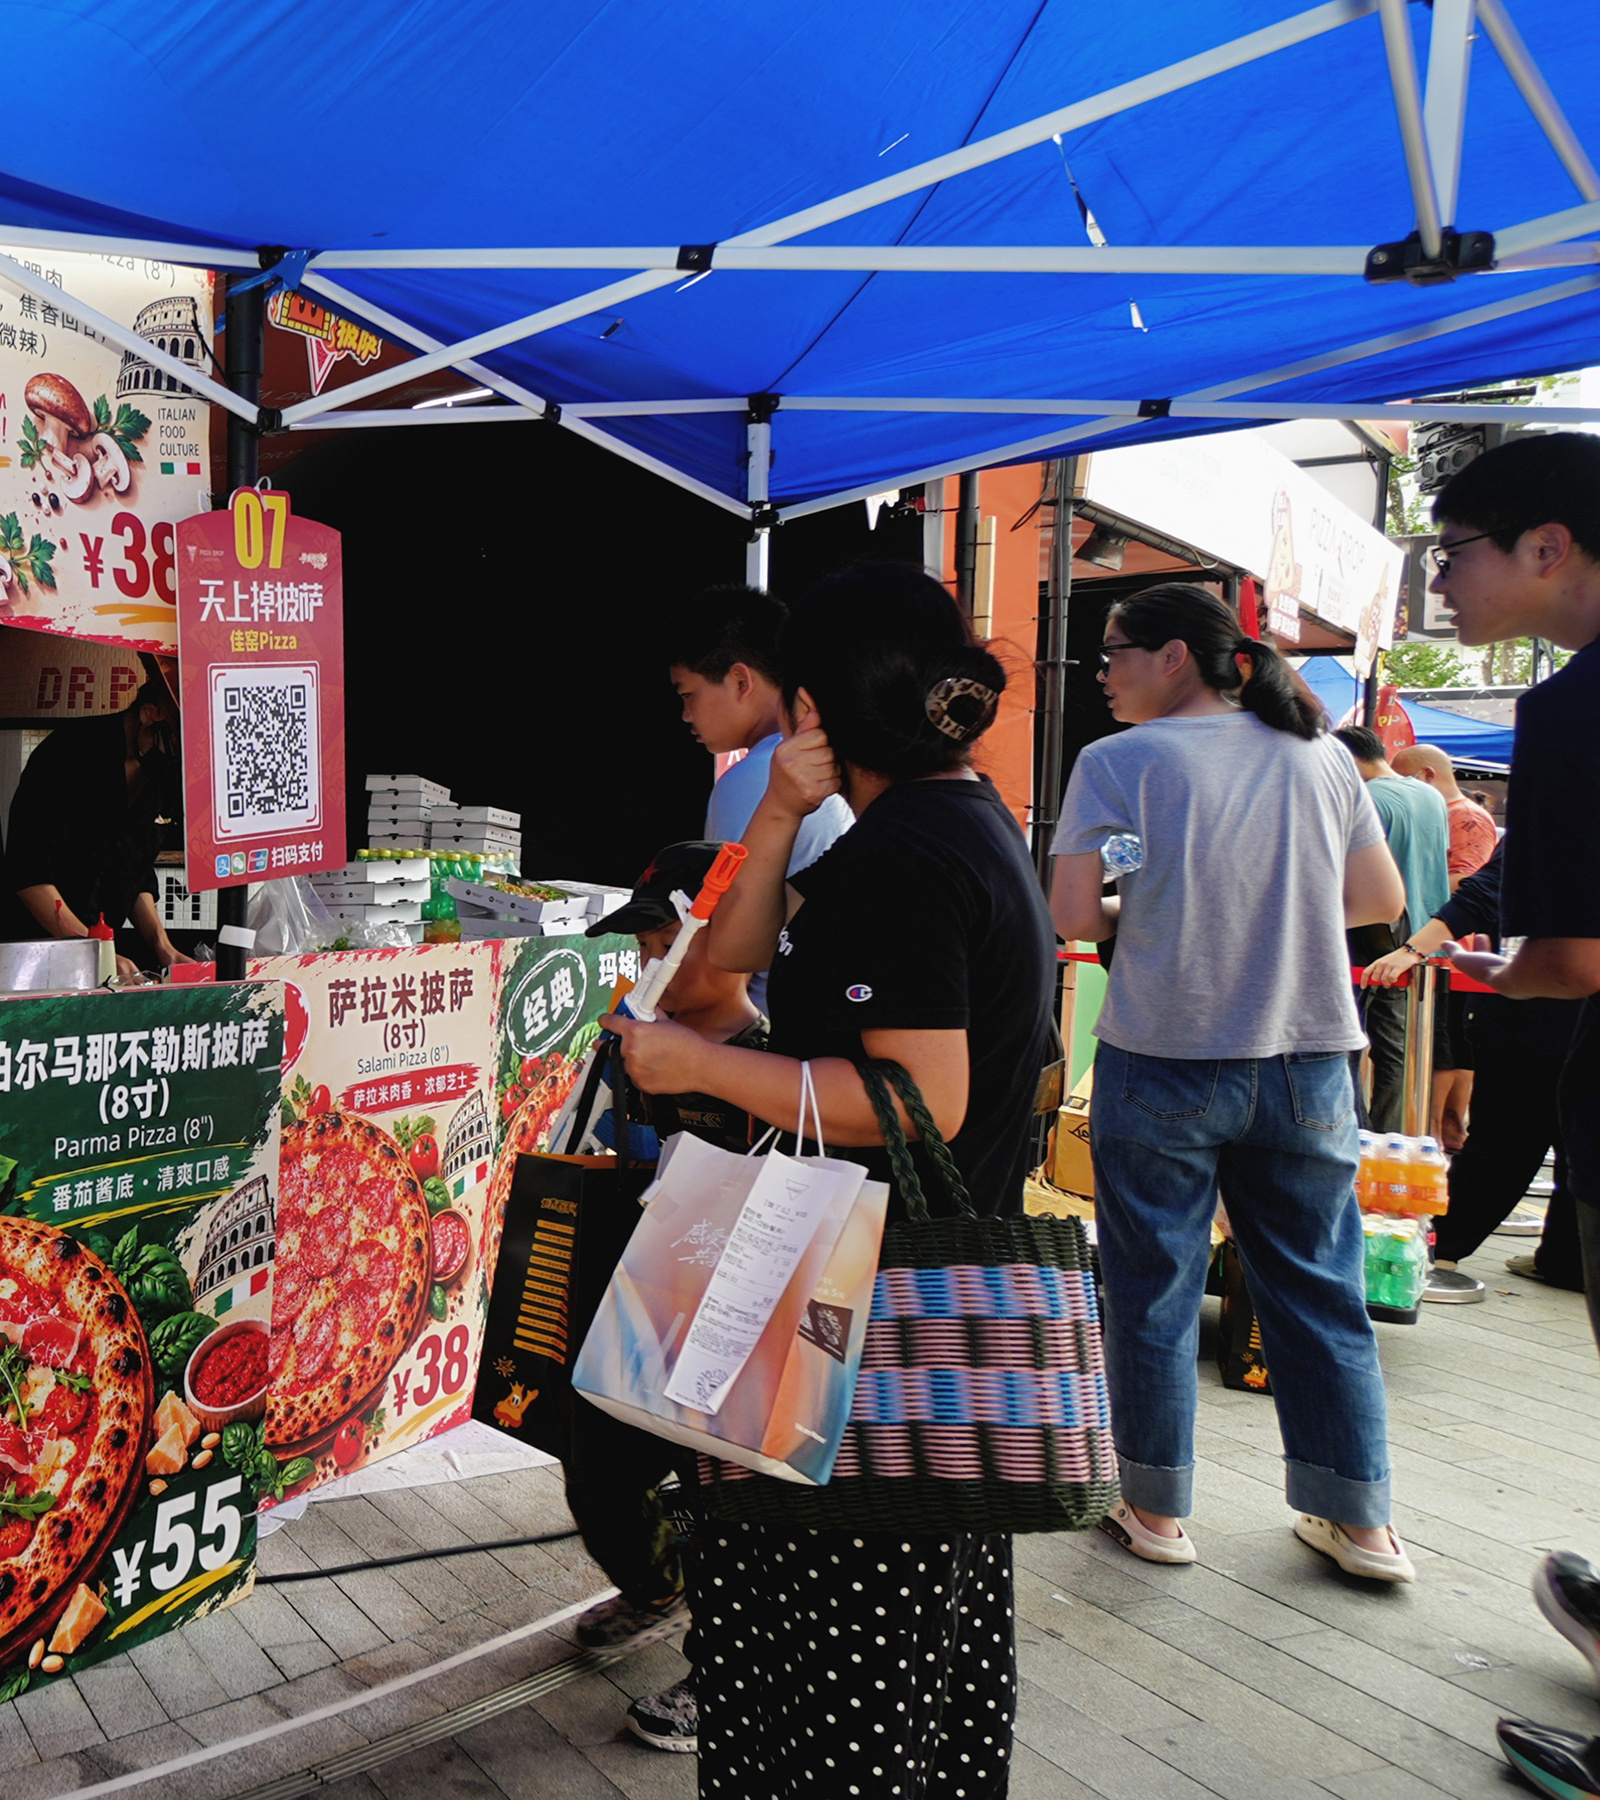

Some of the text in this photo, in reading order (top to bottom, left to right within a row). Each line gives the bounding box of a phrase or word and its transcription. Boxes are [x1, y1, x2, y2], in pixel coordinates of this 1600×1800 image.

[157, 407, 196, 421] ITALIAN
[159, 426, 186, 439] FOOD
[159, 442, 200, 457] CULTURE
[234, 491, 287, 569] 07
[199, 579, 324, 623] 天上掉披萨
[230, 629, 298, 653] 佳窑Pizza
[271, 840, 324, 869] 扫码支付
[599, 949, 642, 988] 玛格
[329, 968, 474, 1028] 萨拉米披萨
[522, 967, 575, 1042] 经典
[383, 1018, 426, 1053] (8寸)
[358, 1054, 396, 1075] Salami
[399, 1051, 427, 1068] Pizza
[99, 1078, 169, 1124] (8寸)
[54, 1133, 121, 1160] Parma
[128, 1124, 176, 1148] Pizza
[392, 1324, 470, 1417] ¥38
[112, 1474, 243, 1608] ¥55
